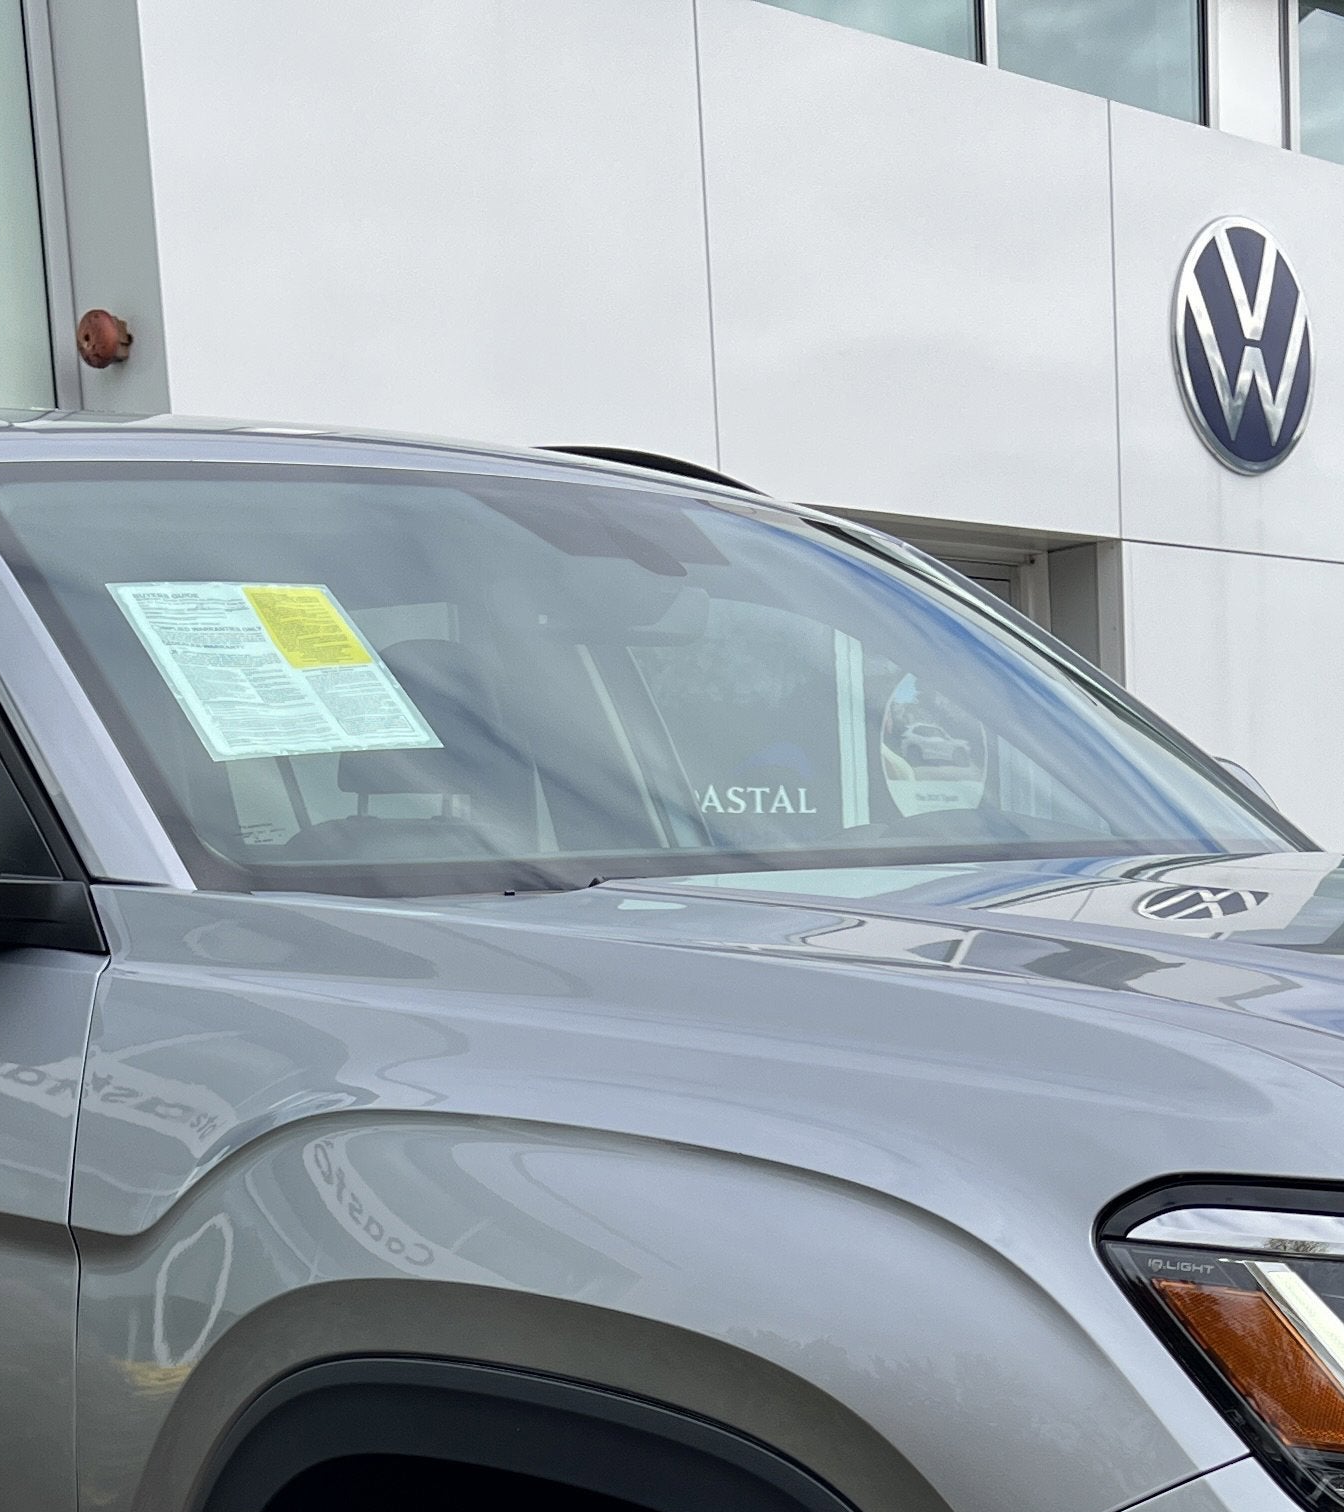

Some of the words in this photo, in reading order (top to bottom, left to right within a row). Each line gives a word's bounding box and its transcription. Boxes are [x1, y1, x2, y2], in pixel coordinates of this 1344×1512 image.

[1179, 219, 1313, 462] VW
[694, 784, 817, 814] ASTAL
[1147, 1257, 1215, 1275] IQ.LIGHT
